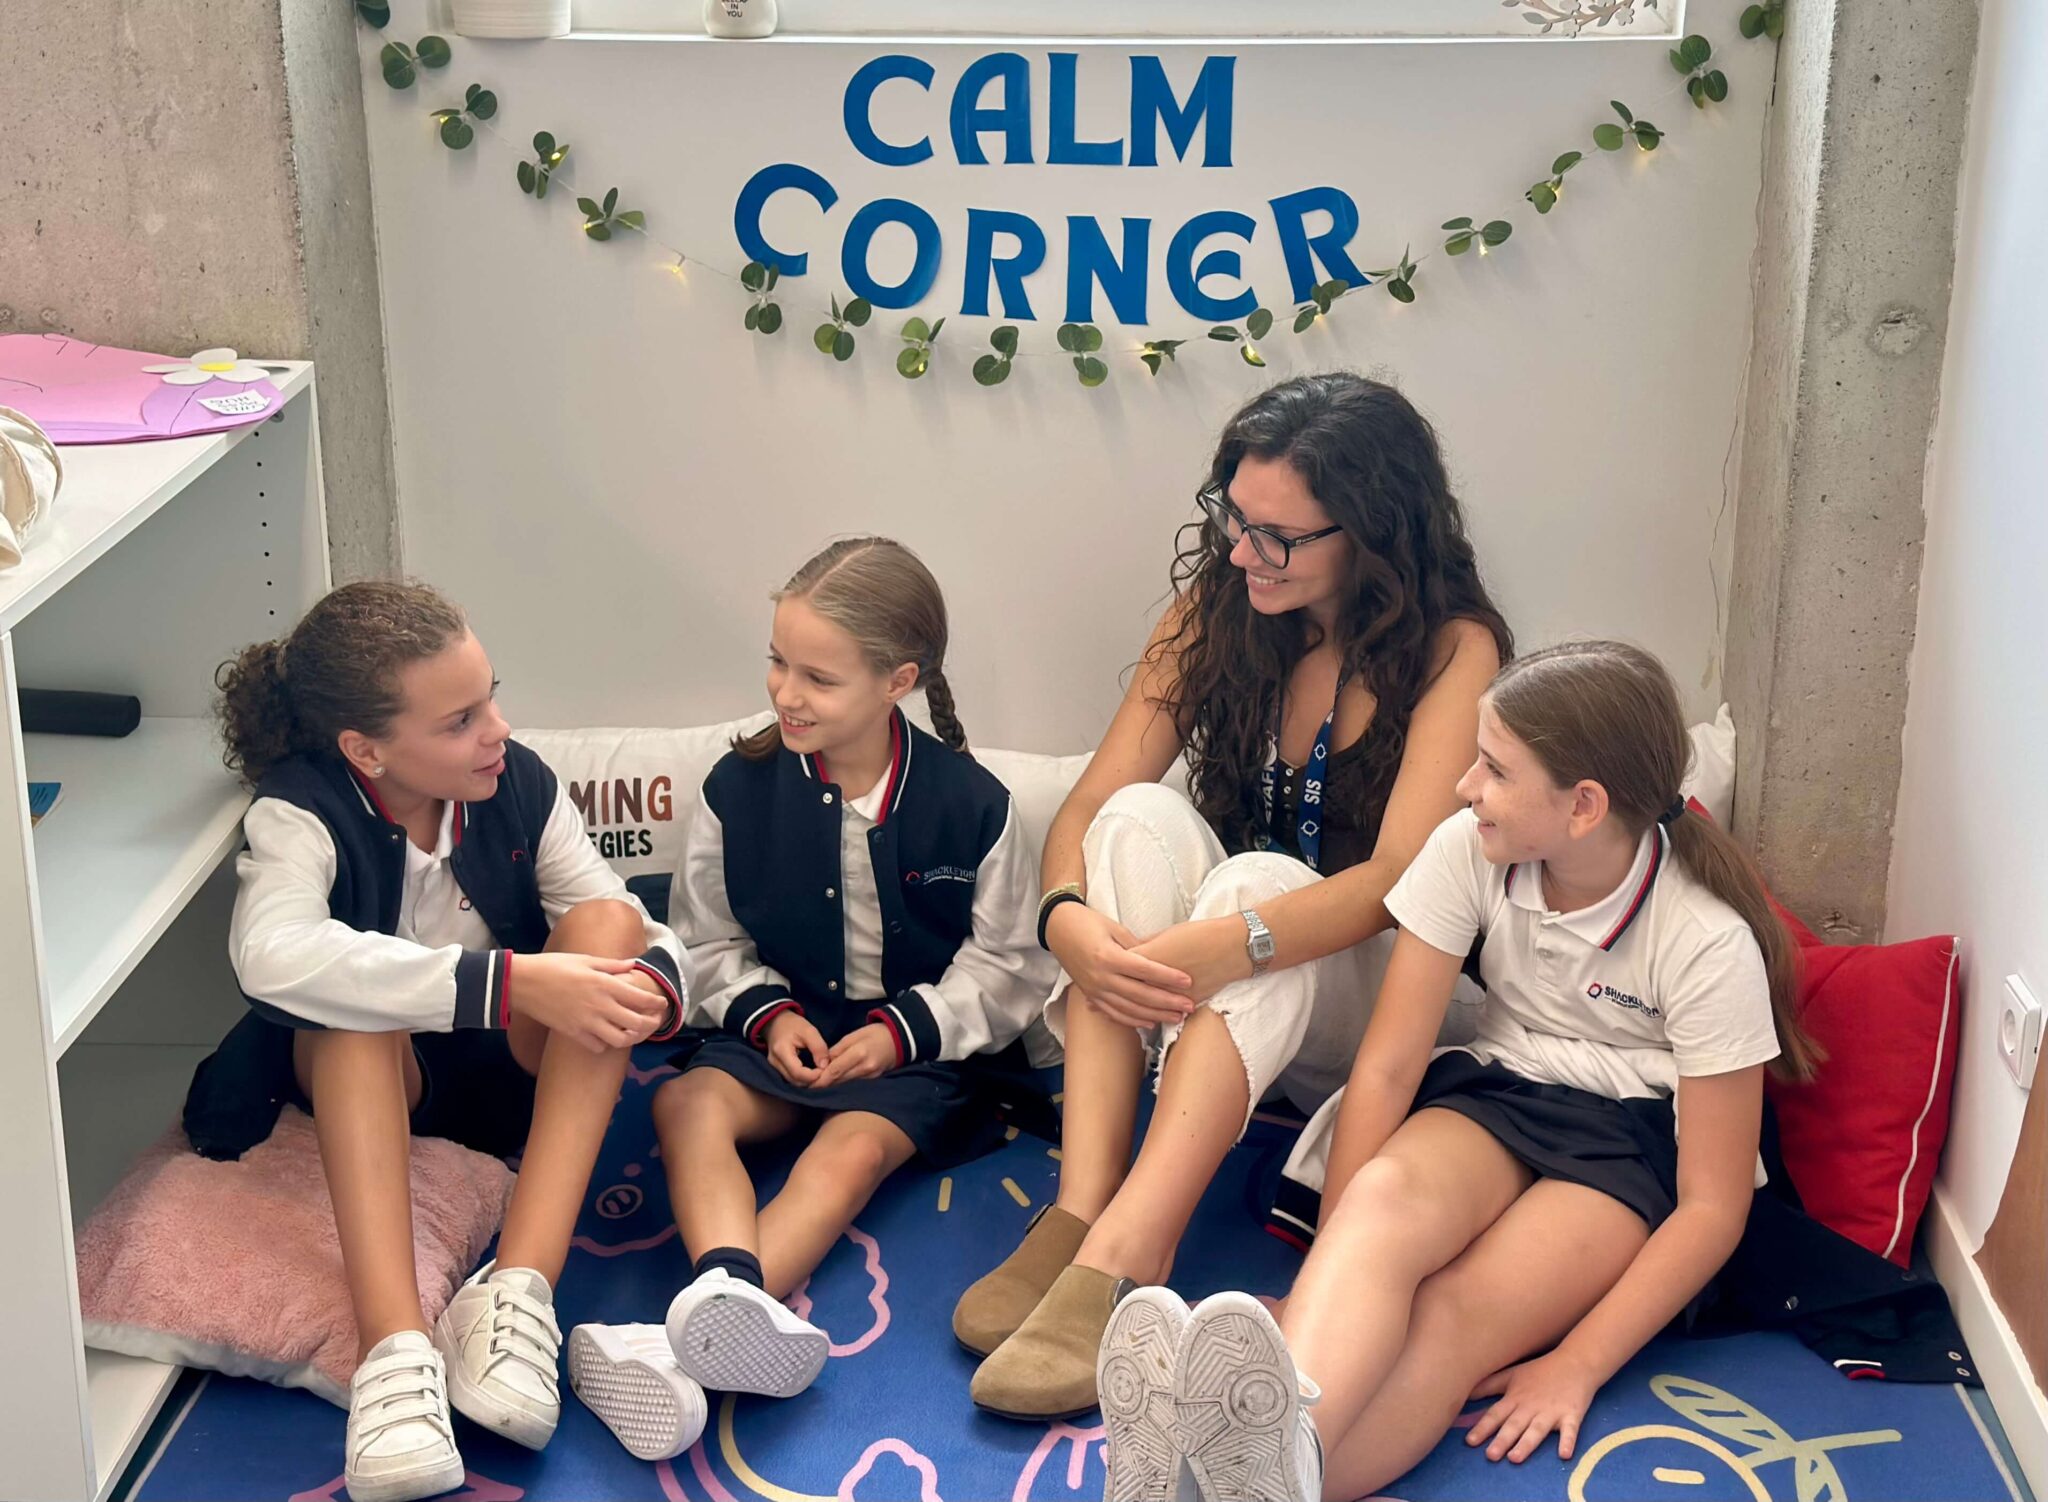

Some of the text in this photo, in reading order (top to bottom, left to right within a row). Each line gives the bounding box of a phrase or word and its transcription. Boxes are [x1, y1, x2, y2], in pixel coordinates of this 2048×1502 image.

[727, 10, 743, 18] YOU
[843, 52, 1237, 168] CALM
[734, 163, 1372, 326] CORNER
[1304, 779, 1321, 805] SIS
